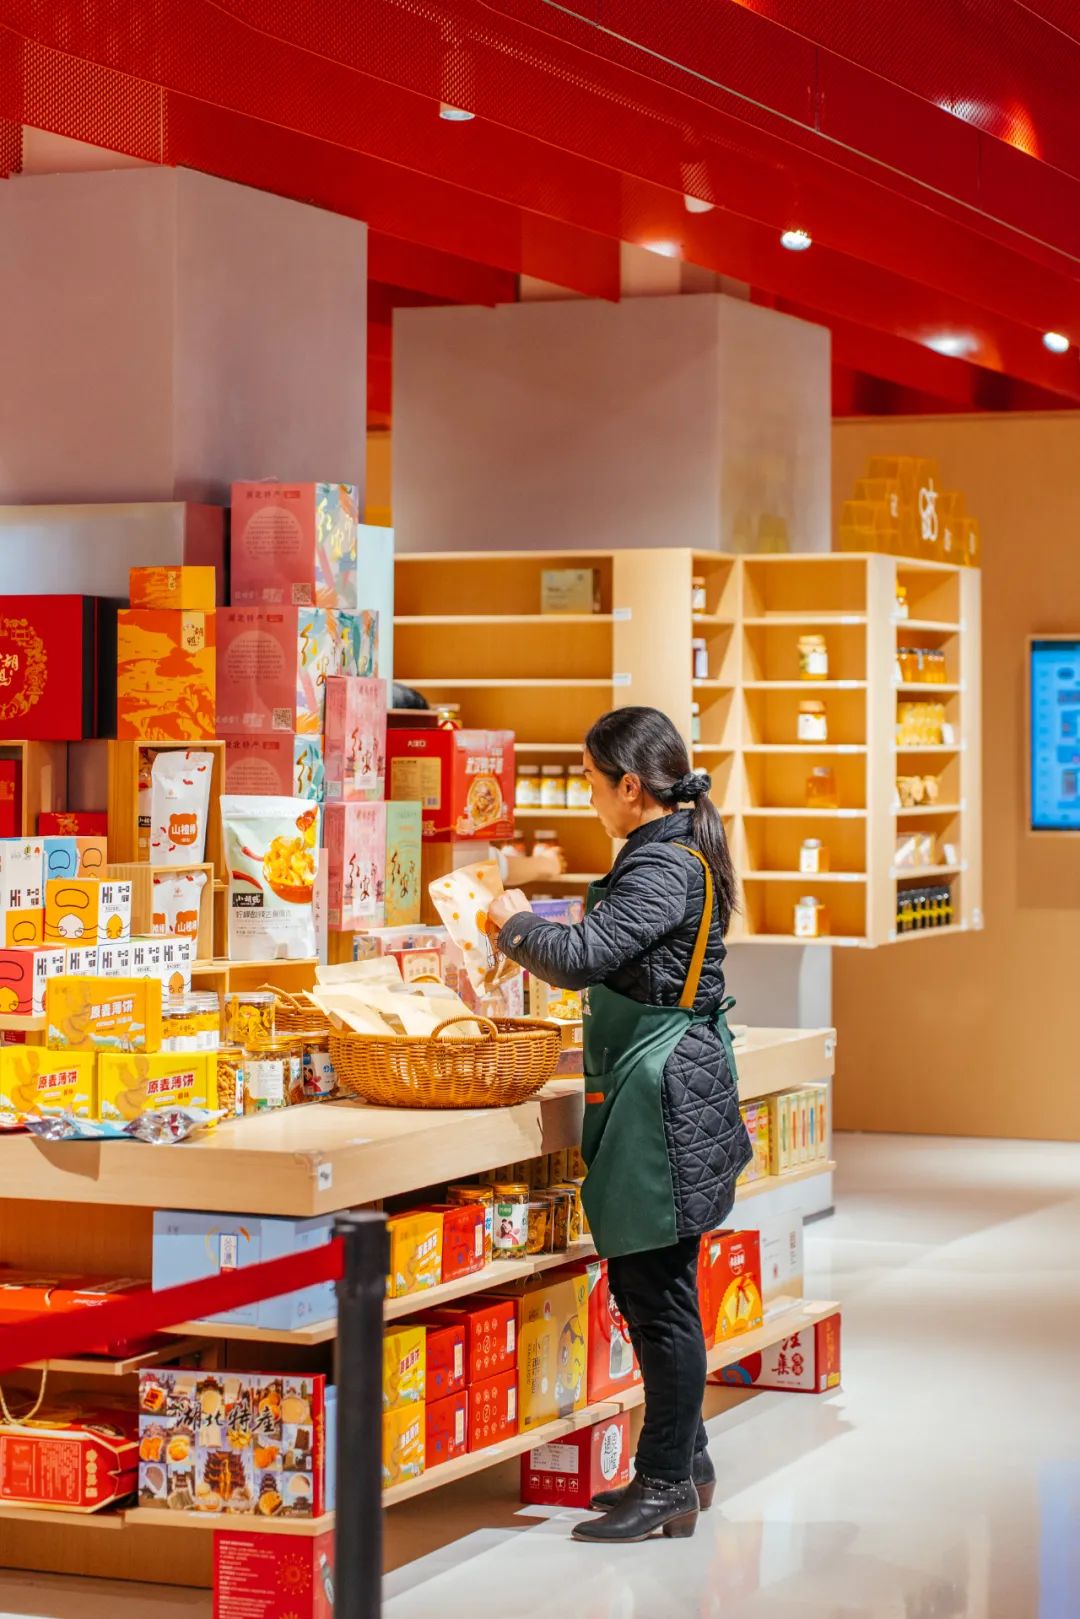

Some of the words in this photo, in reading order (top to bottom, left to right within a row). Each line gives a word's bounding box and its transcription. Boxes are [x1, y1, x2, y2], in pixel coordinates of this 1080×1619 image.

[10, 889, 21, 907] Hi
[102, 886, 113, 904] Hi
[70, 952, 80, 970] Hi
[102, 951, 113, 969] Hi
[134, 947, 144, 965] Hi
[164, 944, 174, 962] Hi
[37, 957, 47, 976] Hi
[90, 999, 133, 1019] 原麦薄饼
[38, 1070, 78, 1090] 原麦薄饼
[147, 1074, 195, 1095] 原麦薄饼
